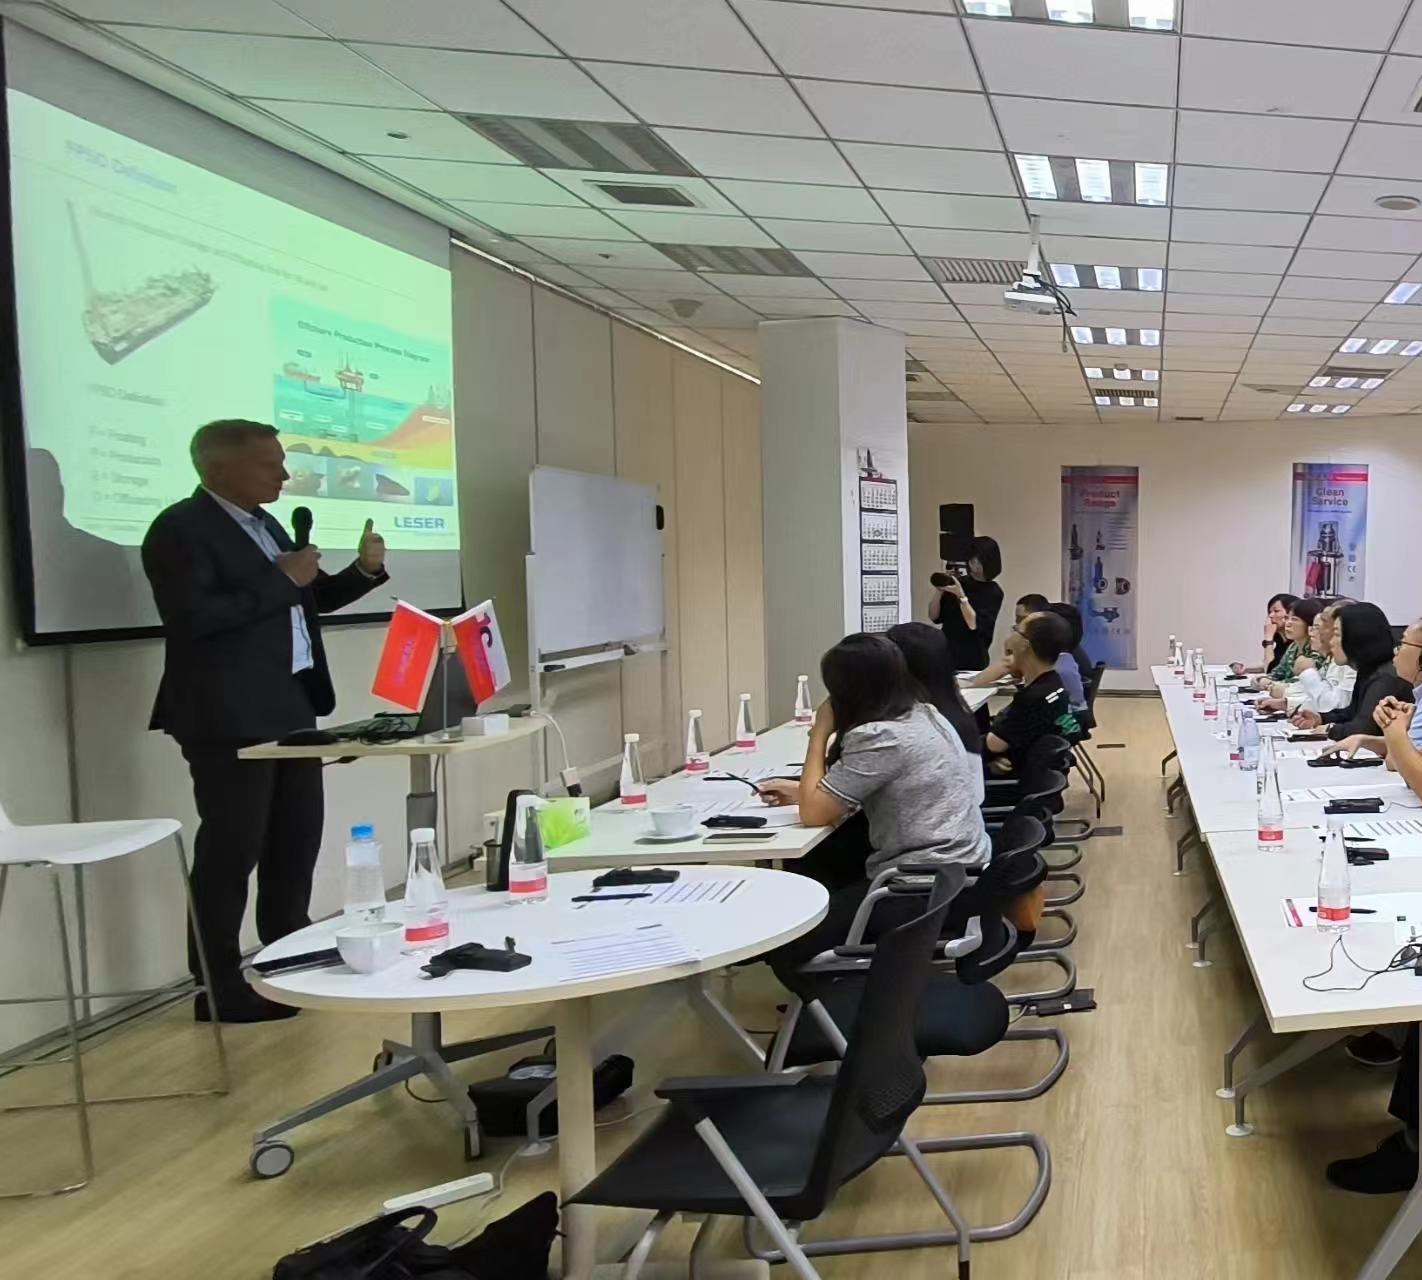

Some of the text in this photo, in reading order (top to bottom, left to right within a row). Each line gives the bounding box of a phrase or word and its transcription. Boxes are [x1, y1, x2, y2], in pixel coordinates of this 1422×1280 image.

[1315, 487, 1346, 497] Clean
[1312, 496, 1350, 506] Service
[394, 516, 445, 529] LESER
